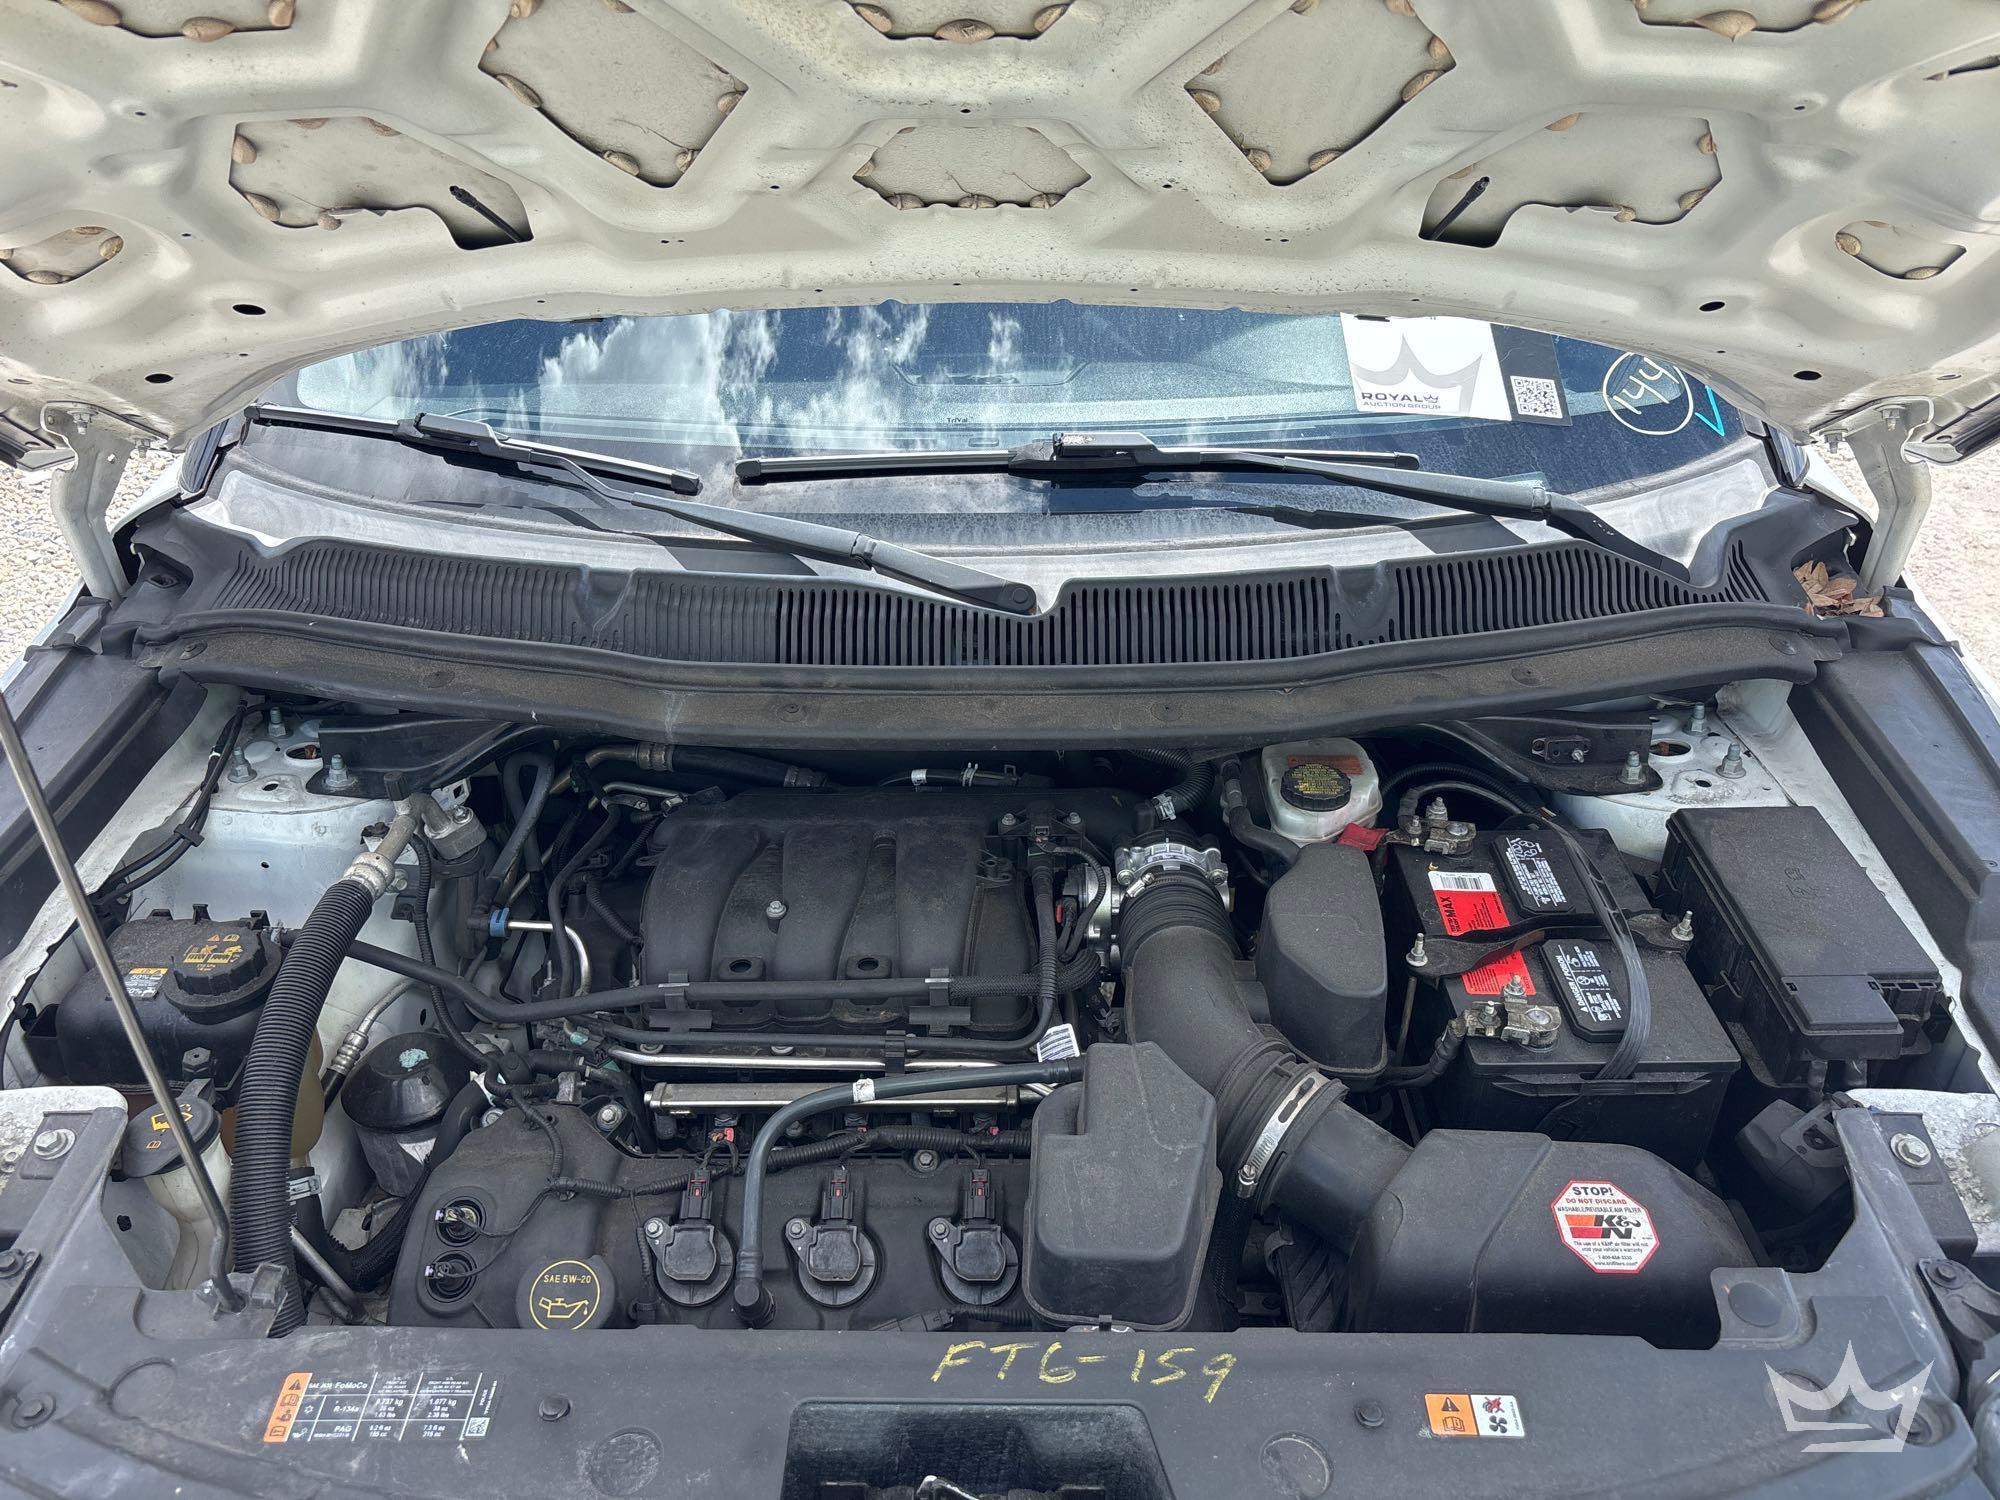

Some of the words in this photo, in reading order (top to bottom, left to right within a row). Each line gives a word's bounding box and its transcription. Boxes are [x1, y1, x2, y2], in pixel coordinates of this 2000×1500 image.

[1612, 357, 1679, 415] 144
[1361, 392, 1423, 402] ROYAL
[1440, 896, 1457, 918] MAX
[1555, 955, 1572, 977] POISON
[1568, 981, 1586, 1006] DANGER
[1572, 1186, 1614, 1196] STOP!
[543, 1275, 561, 1283] SAE
[562, 1275, 591, 1284] 5W-20
[334, 1381, 368, 1389] FoMoCo
